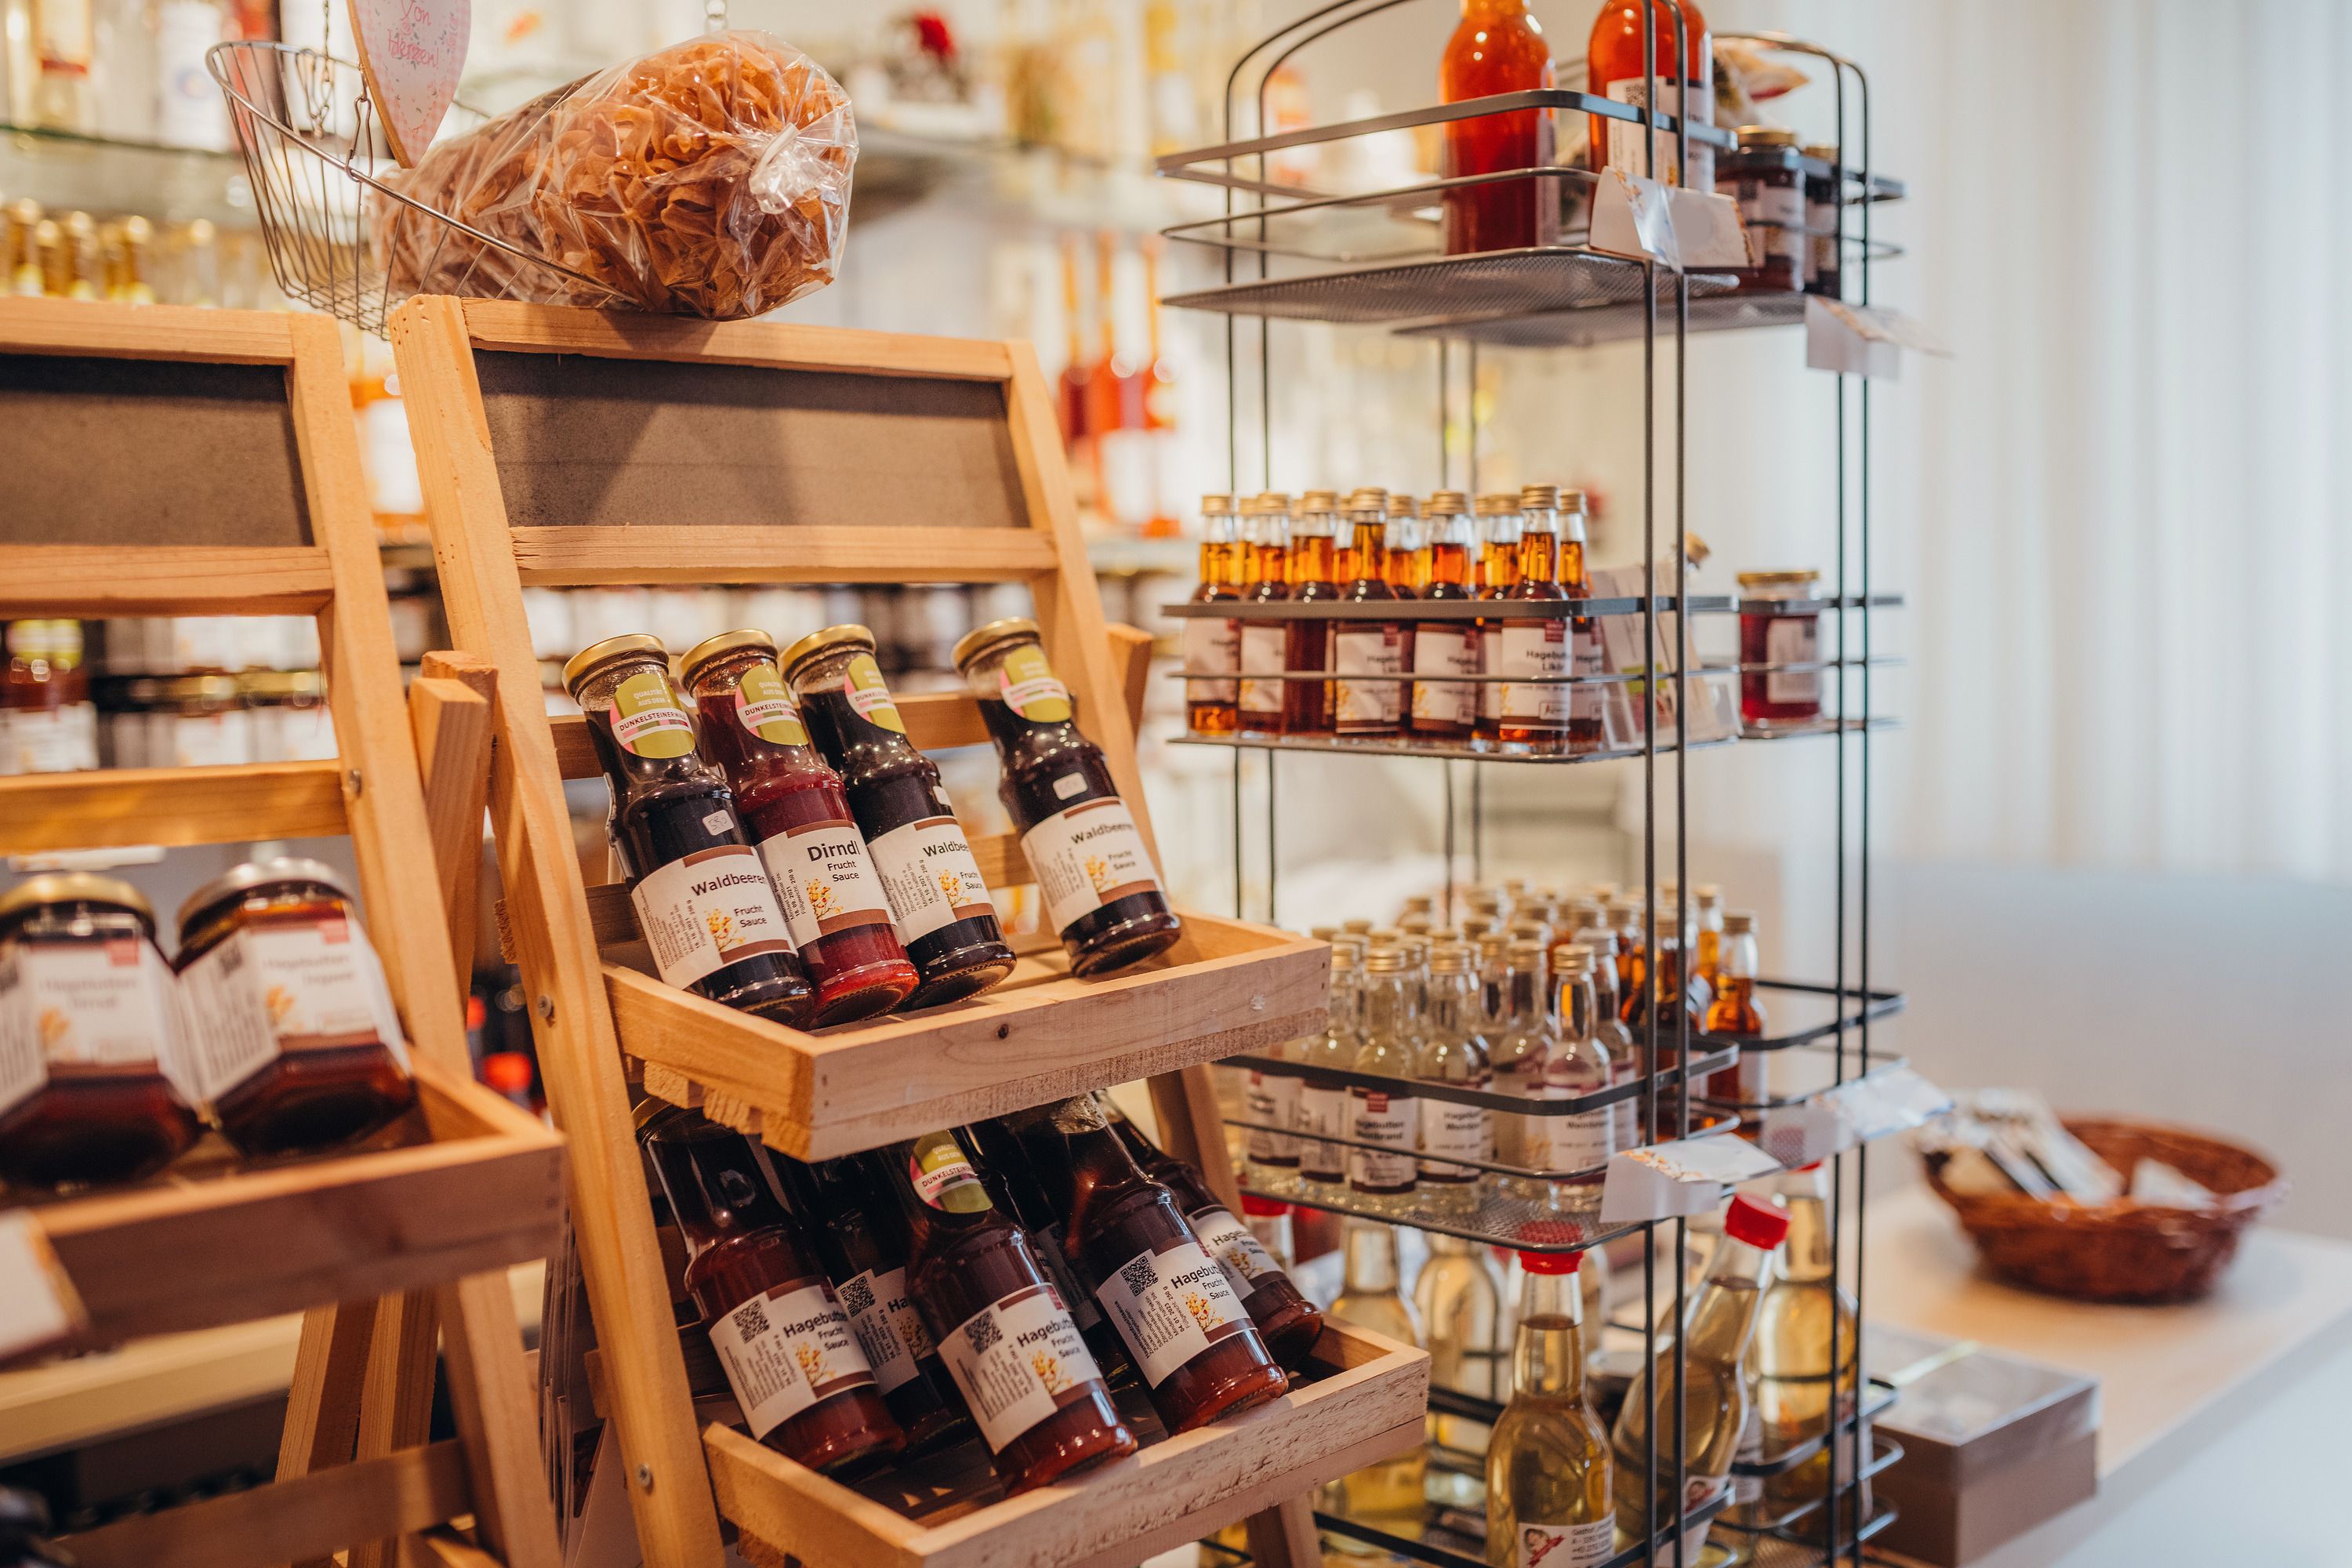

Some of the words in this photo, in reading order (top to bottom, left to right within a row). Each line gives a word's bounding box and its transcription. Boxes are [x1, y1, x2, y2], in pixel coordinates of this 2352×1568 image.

[807, 840, 860, 862] Dirndl
[827, 860, 857, 872] Frucht
[832, 872, 859, 882] Sauce
[734, 905, 764, 916] Frucht
[739, 917, 768, 928] Sauce
[1202, 1279, 1225, 1290] Frucht
[1209, 1290, 1230, 1300] Sauce
[1163, 1301, 1174, 1316] 2023
[824, 1339, 850, 1352] Sauce
